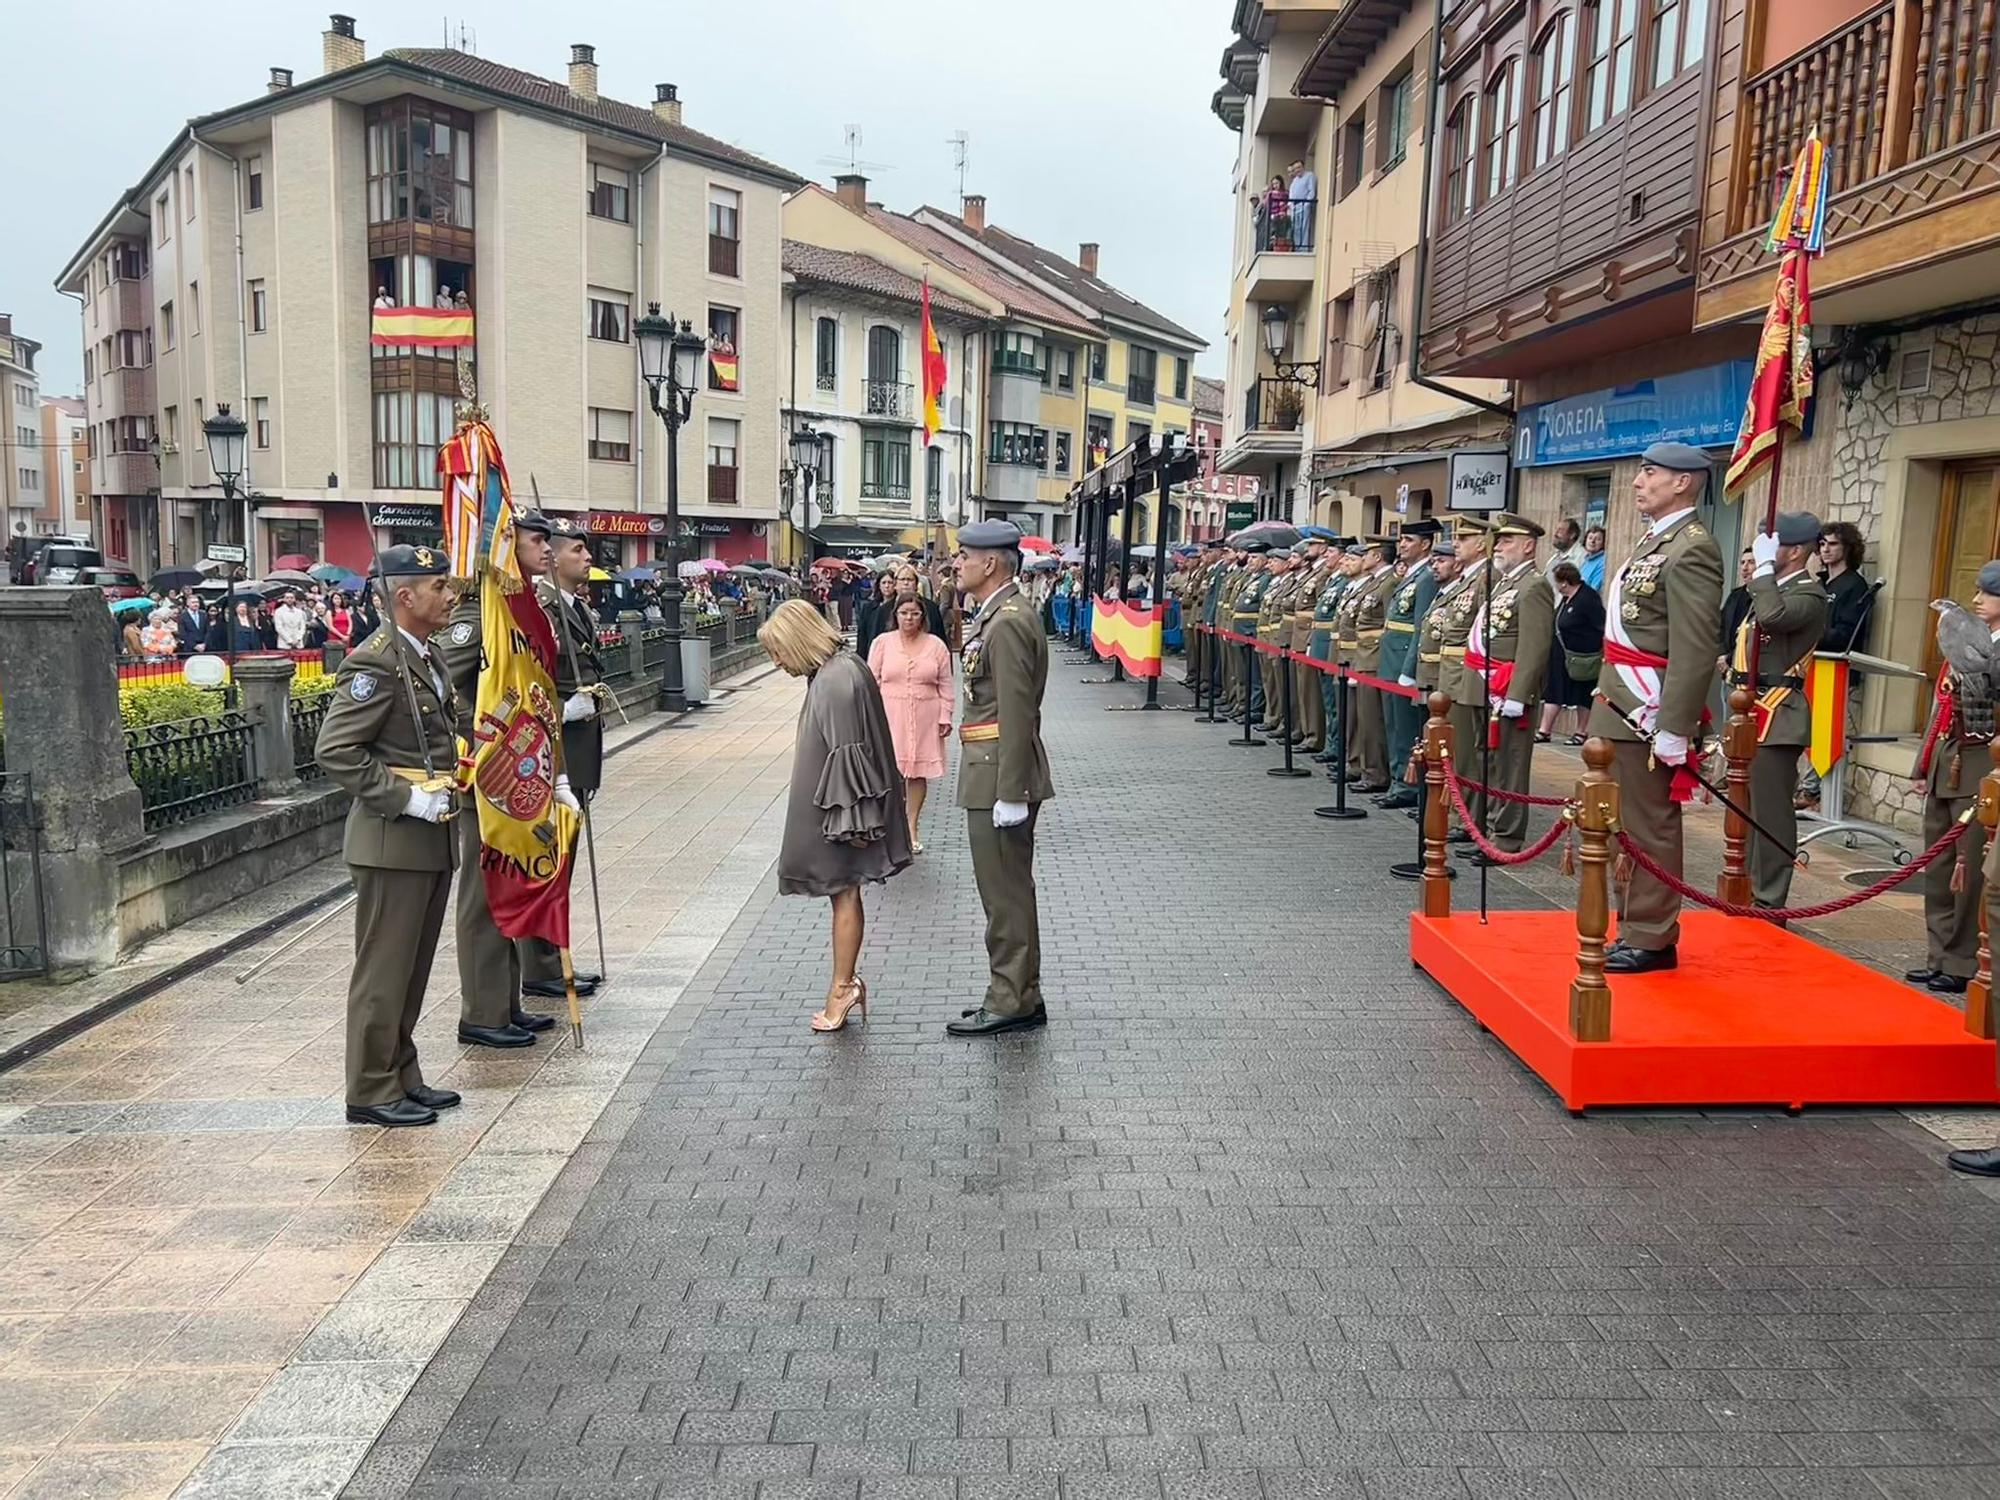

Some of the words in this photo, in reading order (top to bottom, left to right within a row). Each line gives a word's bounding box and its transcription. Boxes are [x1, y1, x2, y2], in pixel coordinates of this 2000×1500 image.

[1455, 474, 1502, 490] HATCHET
[591, 515, 606, 531] de
[608, 515, 647, 532] Marco
